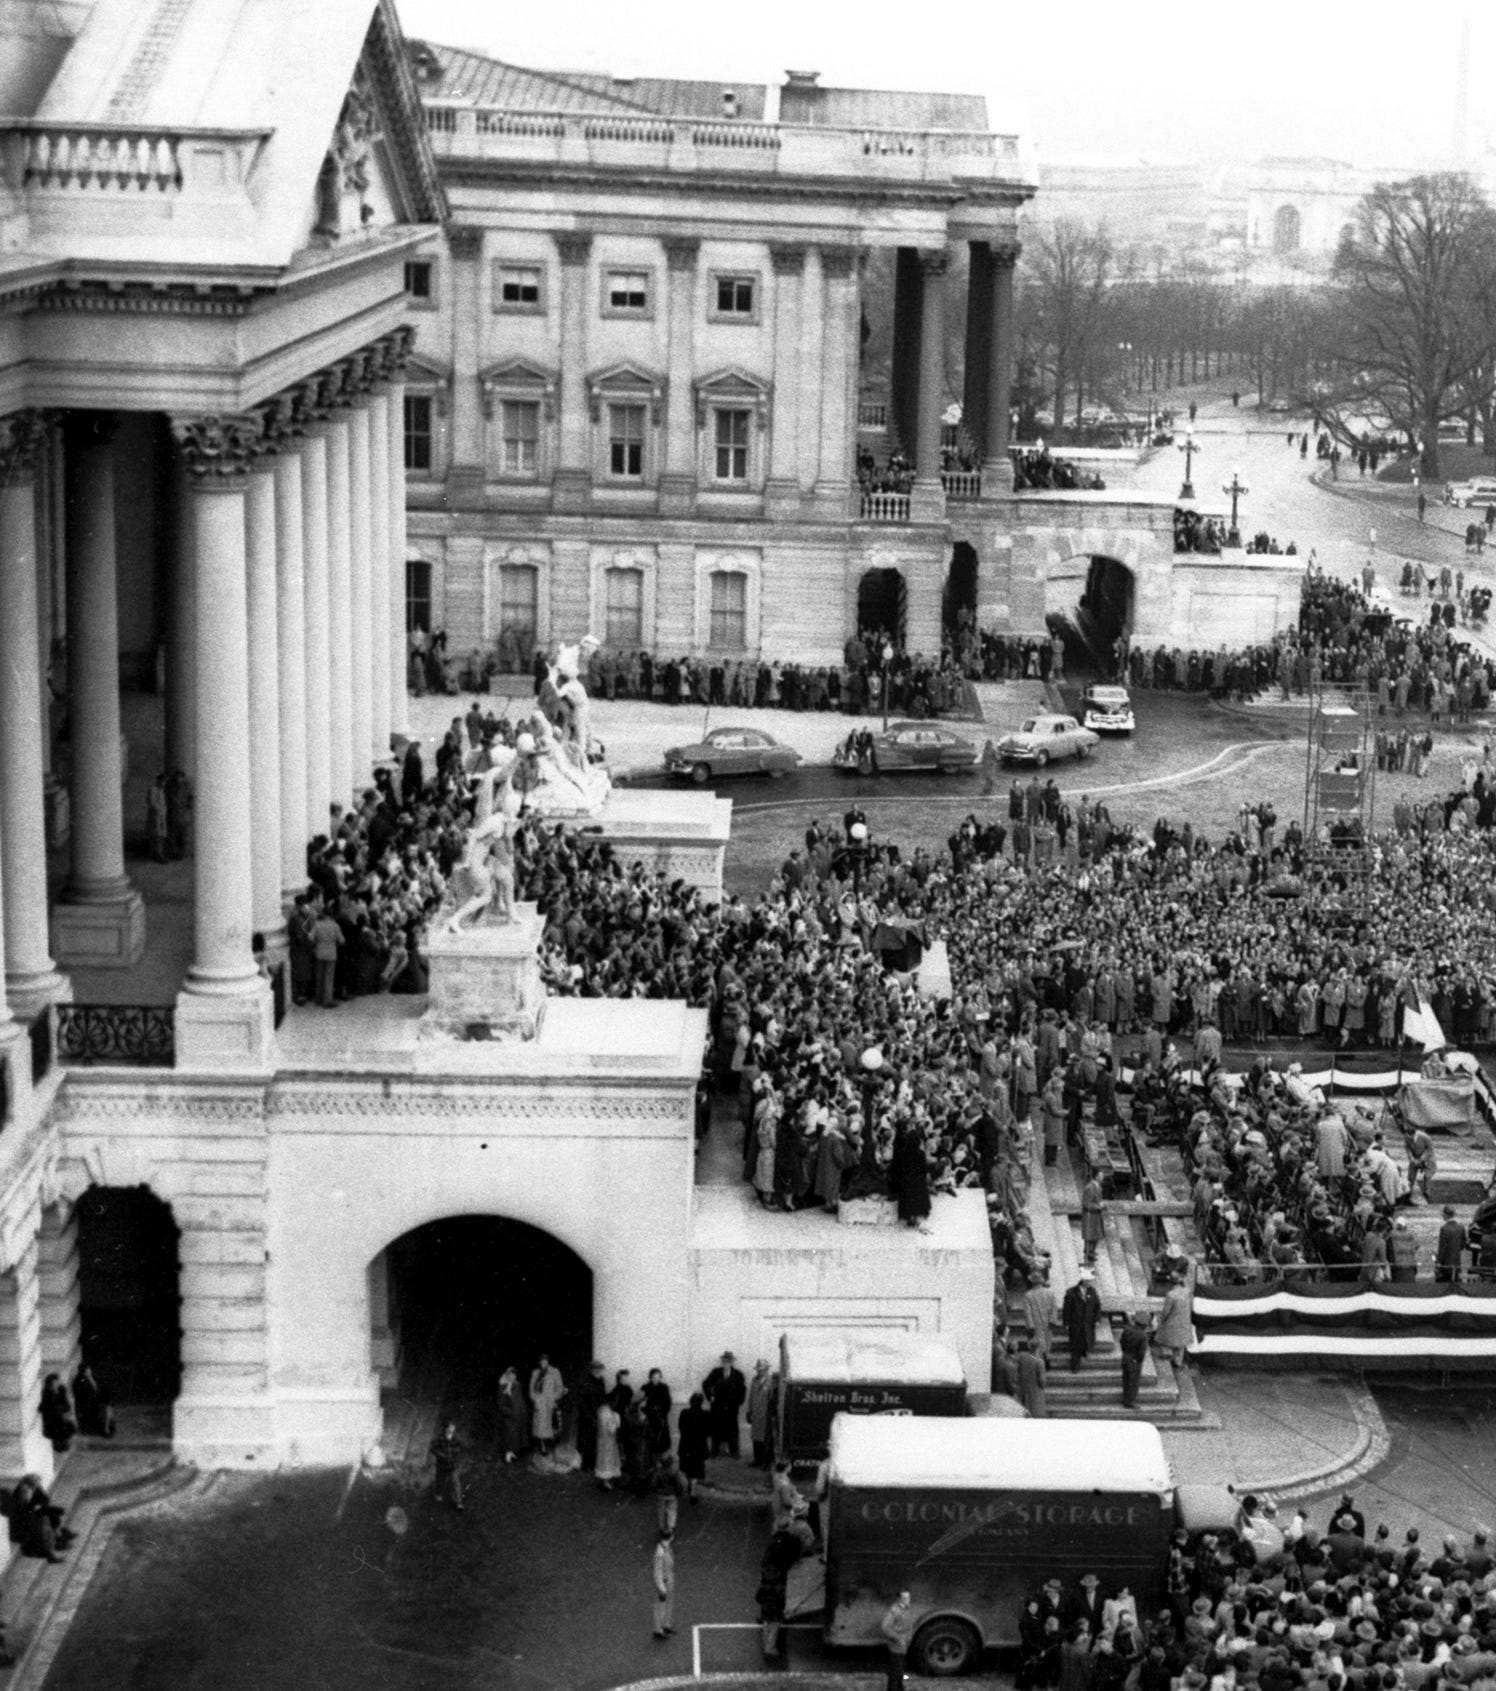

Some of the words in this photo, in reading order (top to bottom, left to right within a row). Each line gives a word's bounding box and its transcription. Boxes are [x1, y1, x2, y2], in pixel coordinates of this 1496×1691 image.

[800, 1390, 846, 1403] Shelton
[861, 1501, 997, 1522] COLONIAL
[1015, 1504, 1141, 1525] STORAGE
